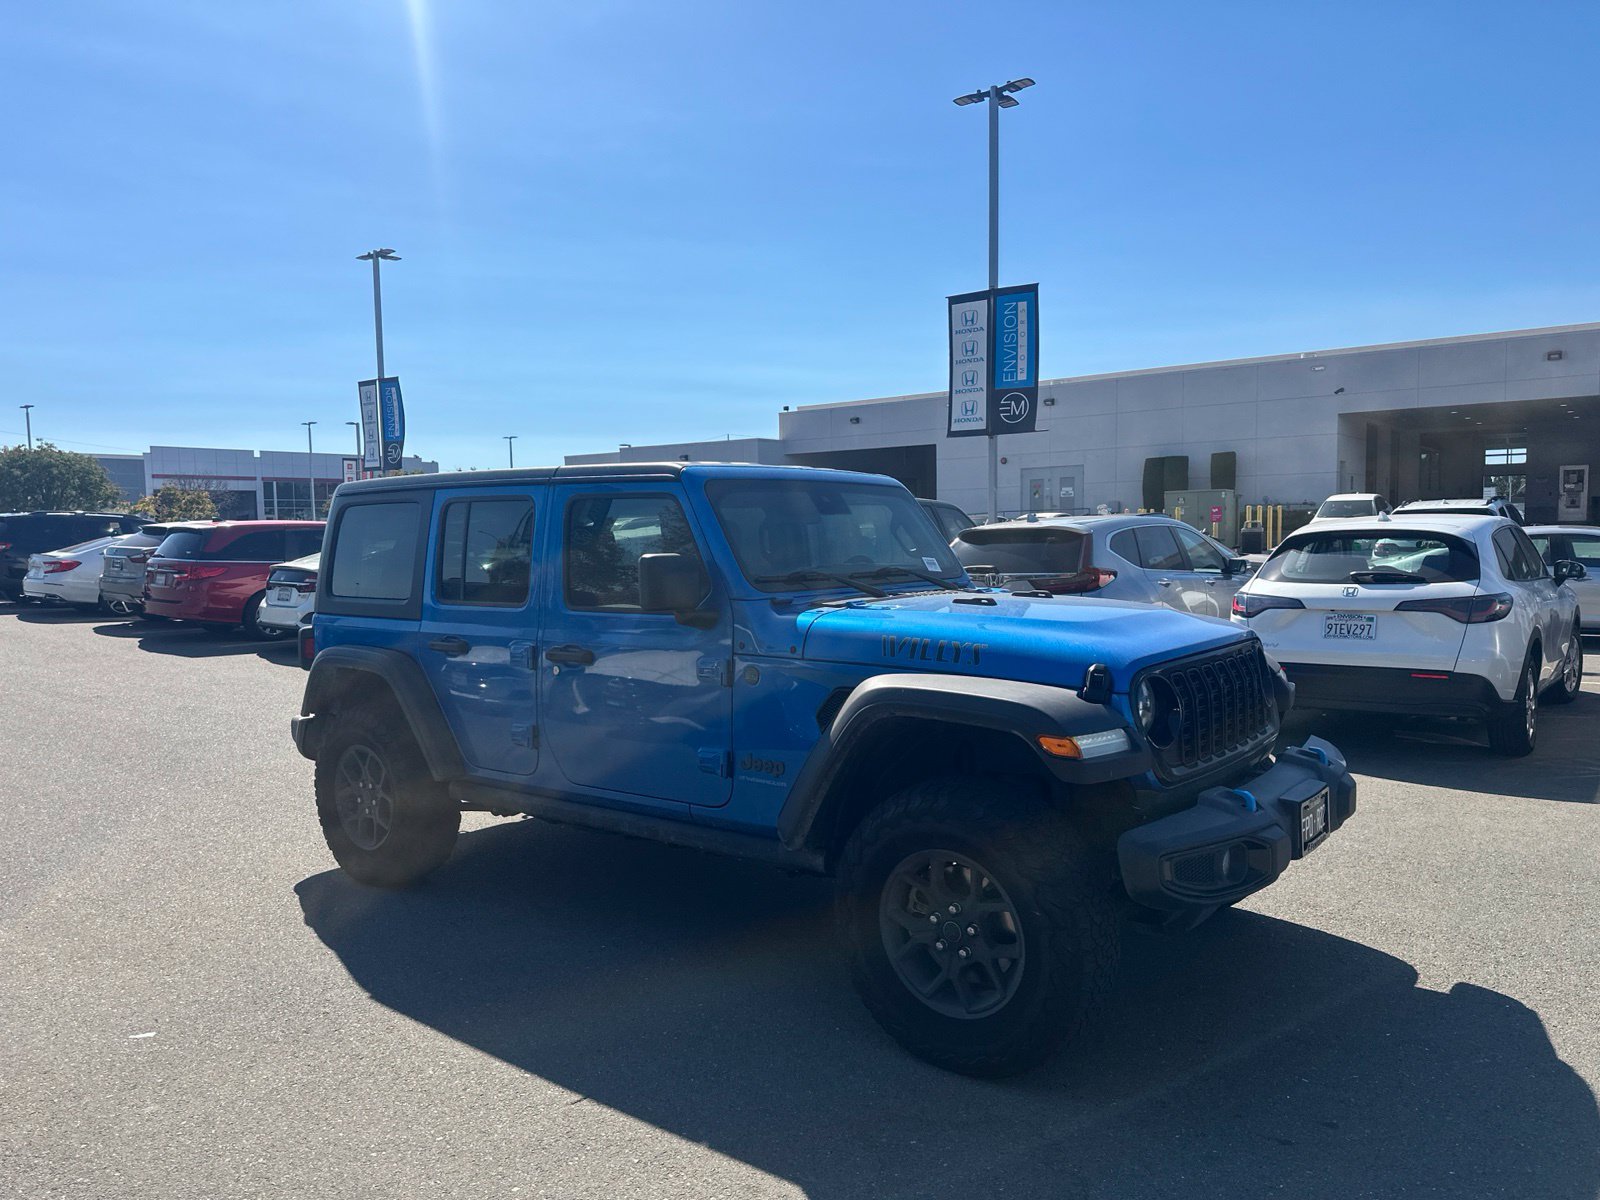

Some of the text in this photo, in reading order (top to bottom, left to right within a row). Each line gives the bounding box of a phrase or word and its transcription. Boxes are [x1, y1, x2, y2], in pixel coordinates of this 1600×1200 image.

[954, 326, 985, 335] HONDA
[1003, 302, 1017, 382] ENVISION
[955, 357, 985, 365] HONDA
[954, 387, 985, 395] HONDA
[953, 416, 984, 424] HONDA
[1326, 623, 1372, 636] 9TEV297
[881, 635, 988, 665] WILLYS
[741, 752, 785, 778] Jeep
